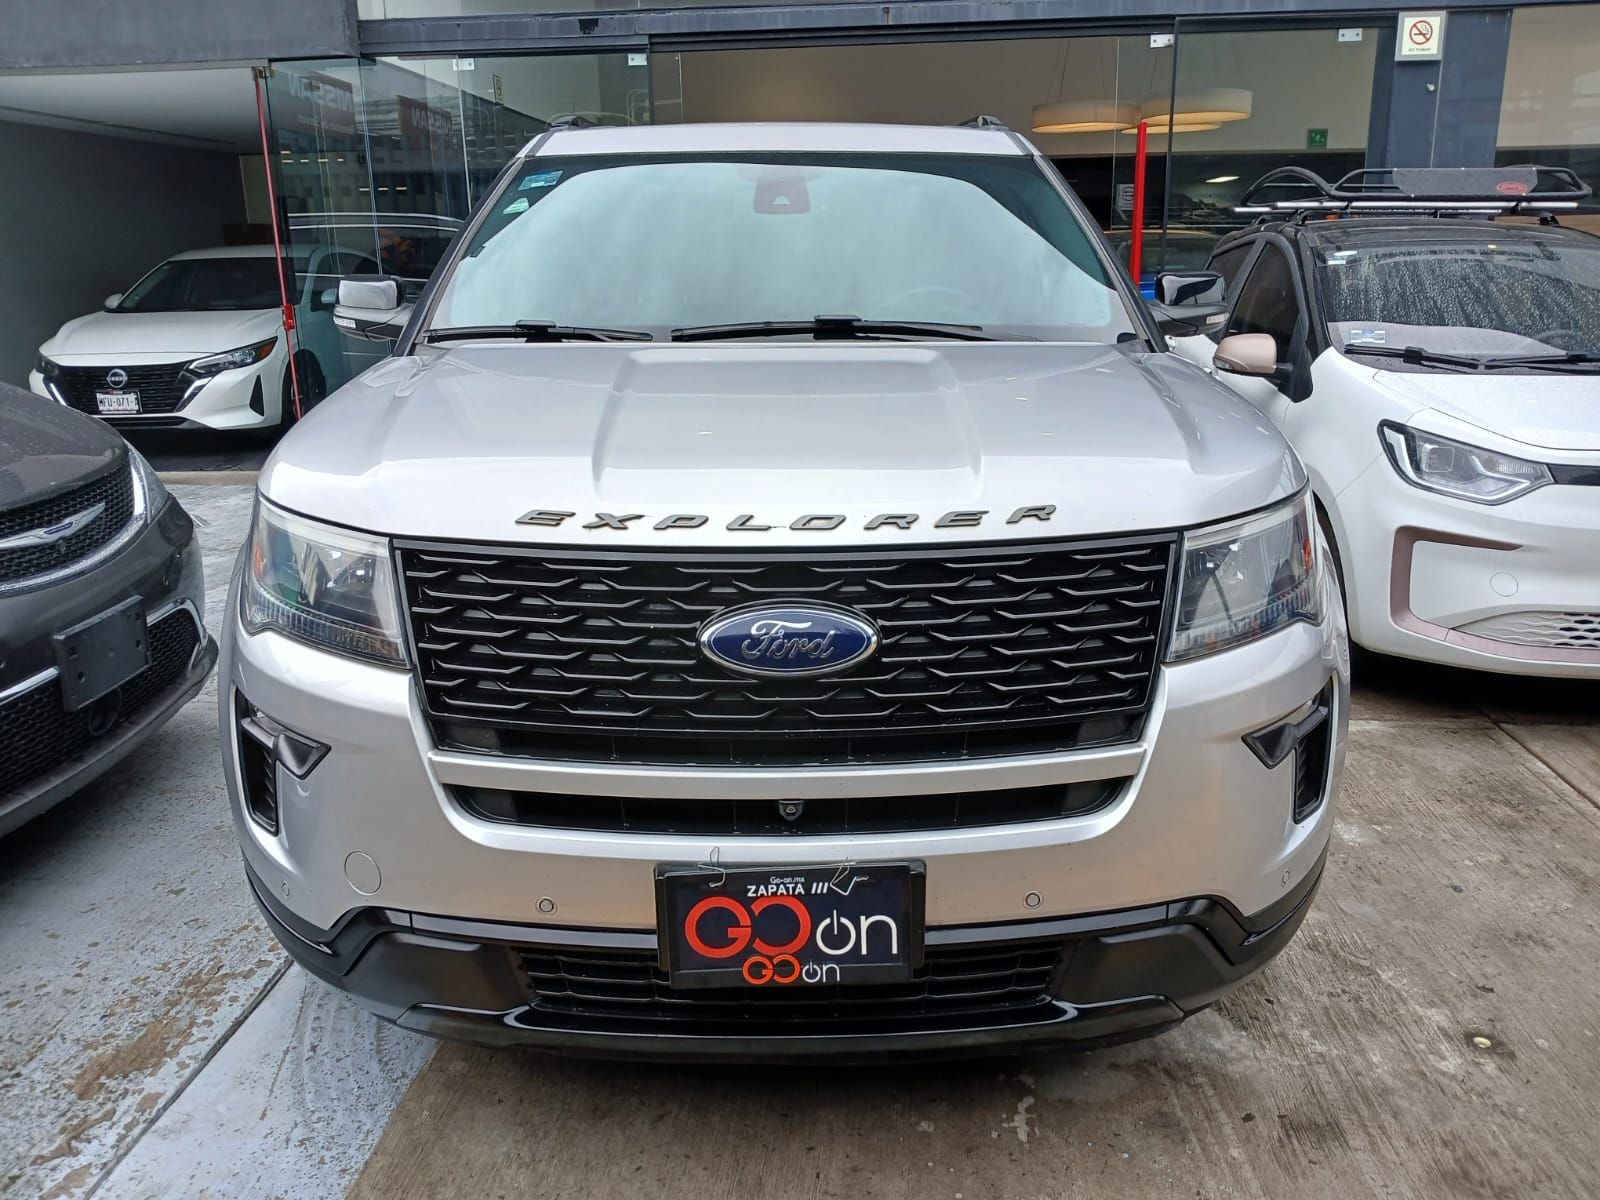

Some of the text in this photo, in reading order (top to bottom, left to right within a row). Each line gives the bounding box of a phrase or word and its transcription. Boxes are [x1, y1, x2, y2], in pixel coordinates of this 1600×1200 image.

[515, 504, 1057, 531] EXPLORER
[741, 620, 836, 659] Ford
[747, 884, 805, 897] ZAPATA
